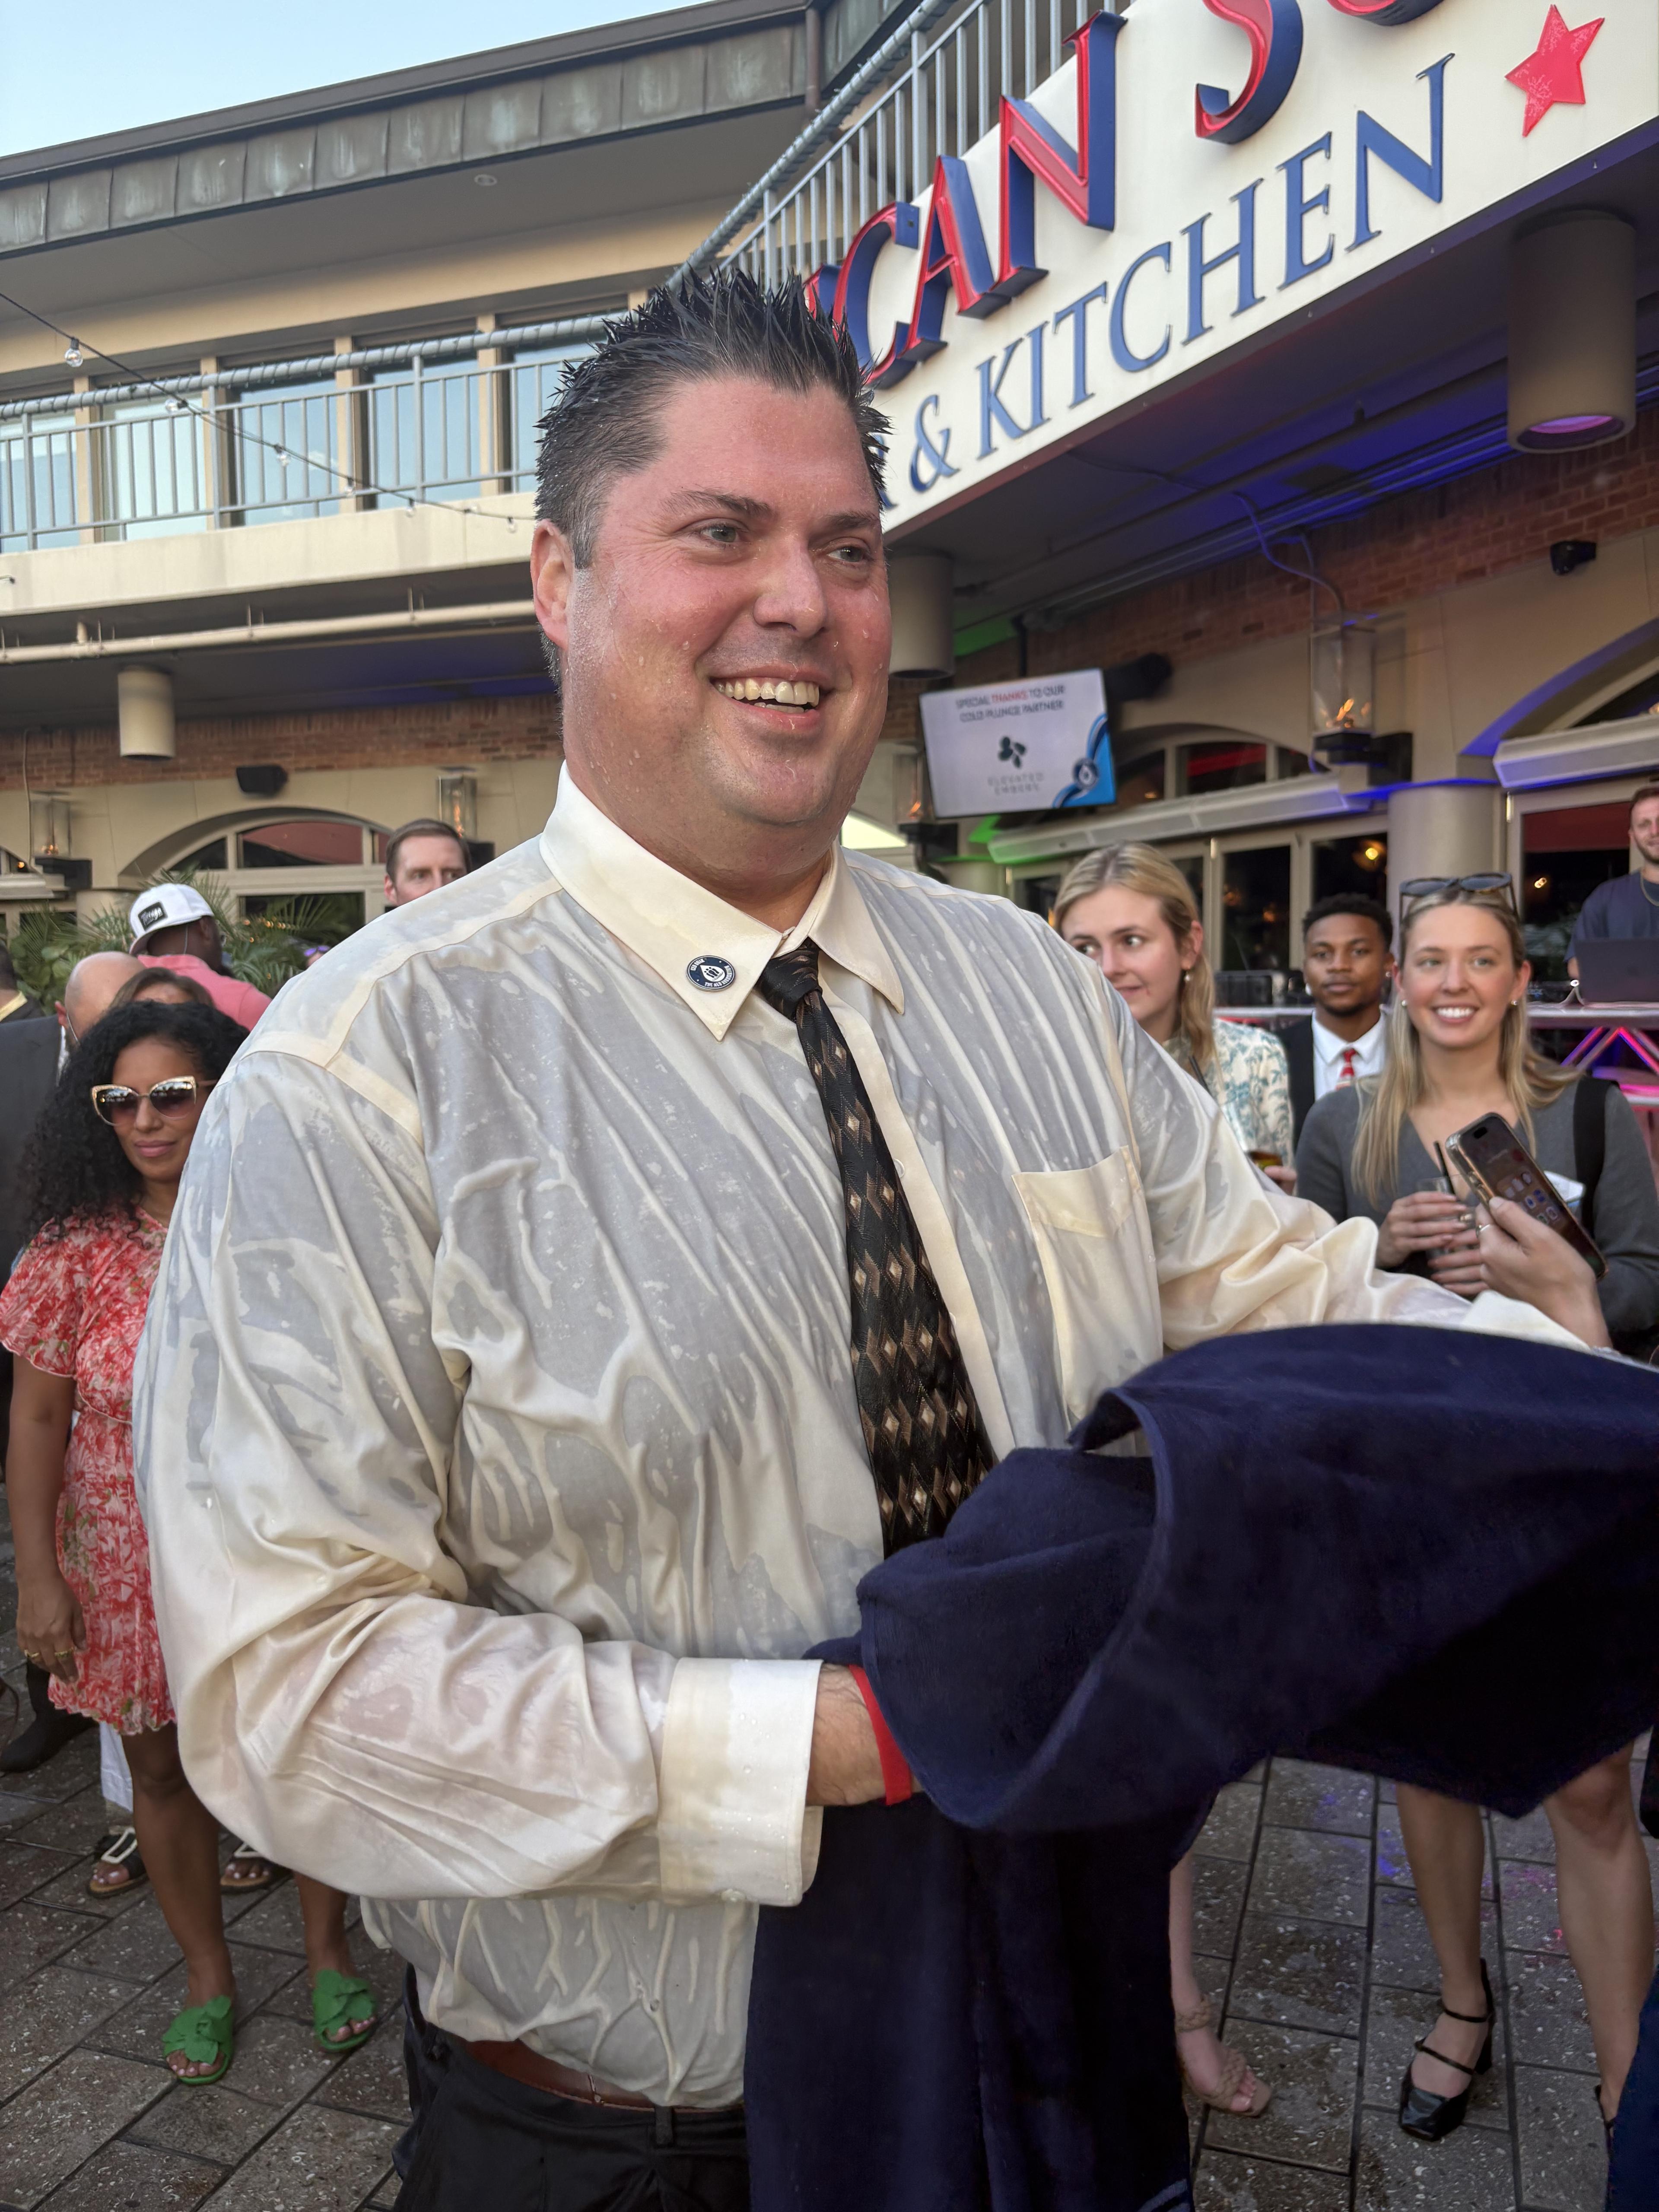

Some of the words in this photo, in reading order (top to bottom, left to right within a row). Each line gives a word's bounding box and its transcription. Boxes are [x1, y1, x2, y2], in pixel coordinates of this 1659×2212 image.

[909, 394, 960, 493] &
[975, 52, 1455, 461] KITCHEN
[956, 696, 990, 709] SPECIAL
[992, 690, 1028, 702] THANKS
[1029, 688, 1042, 699] TO
[1043, 684, 1065, 696] OUR
[960, 711, 984, 722] COLD
[985, 706, 1021, 718] PLUNGE
[1022, 700, 1063, 712] PARTNER
